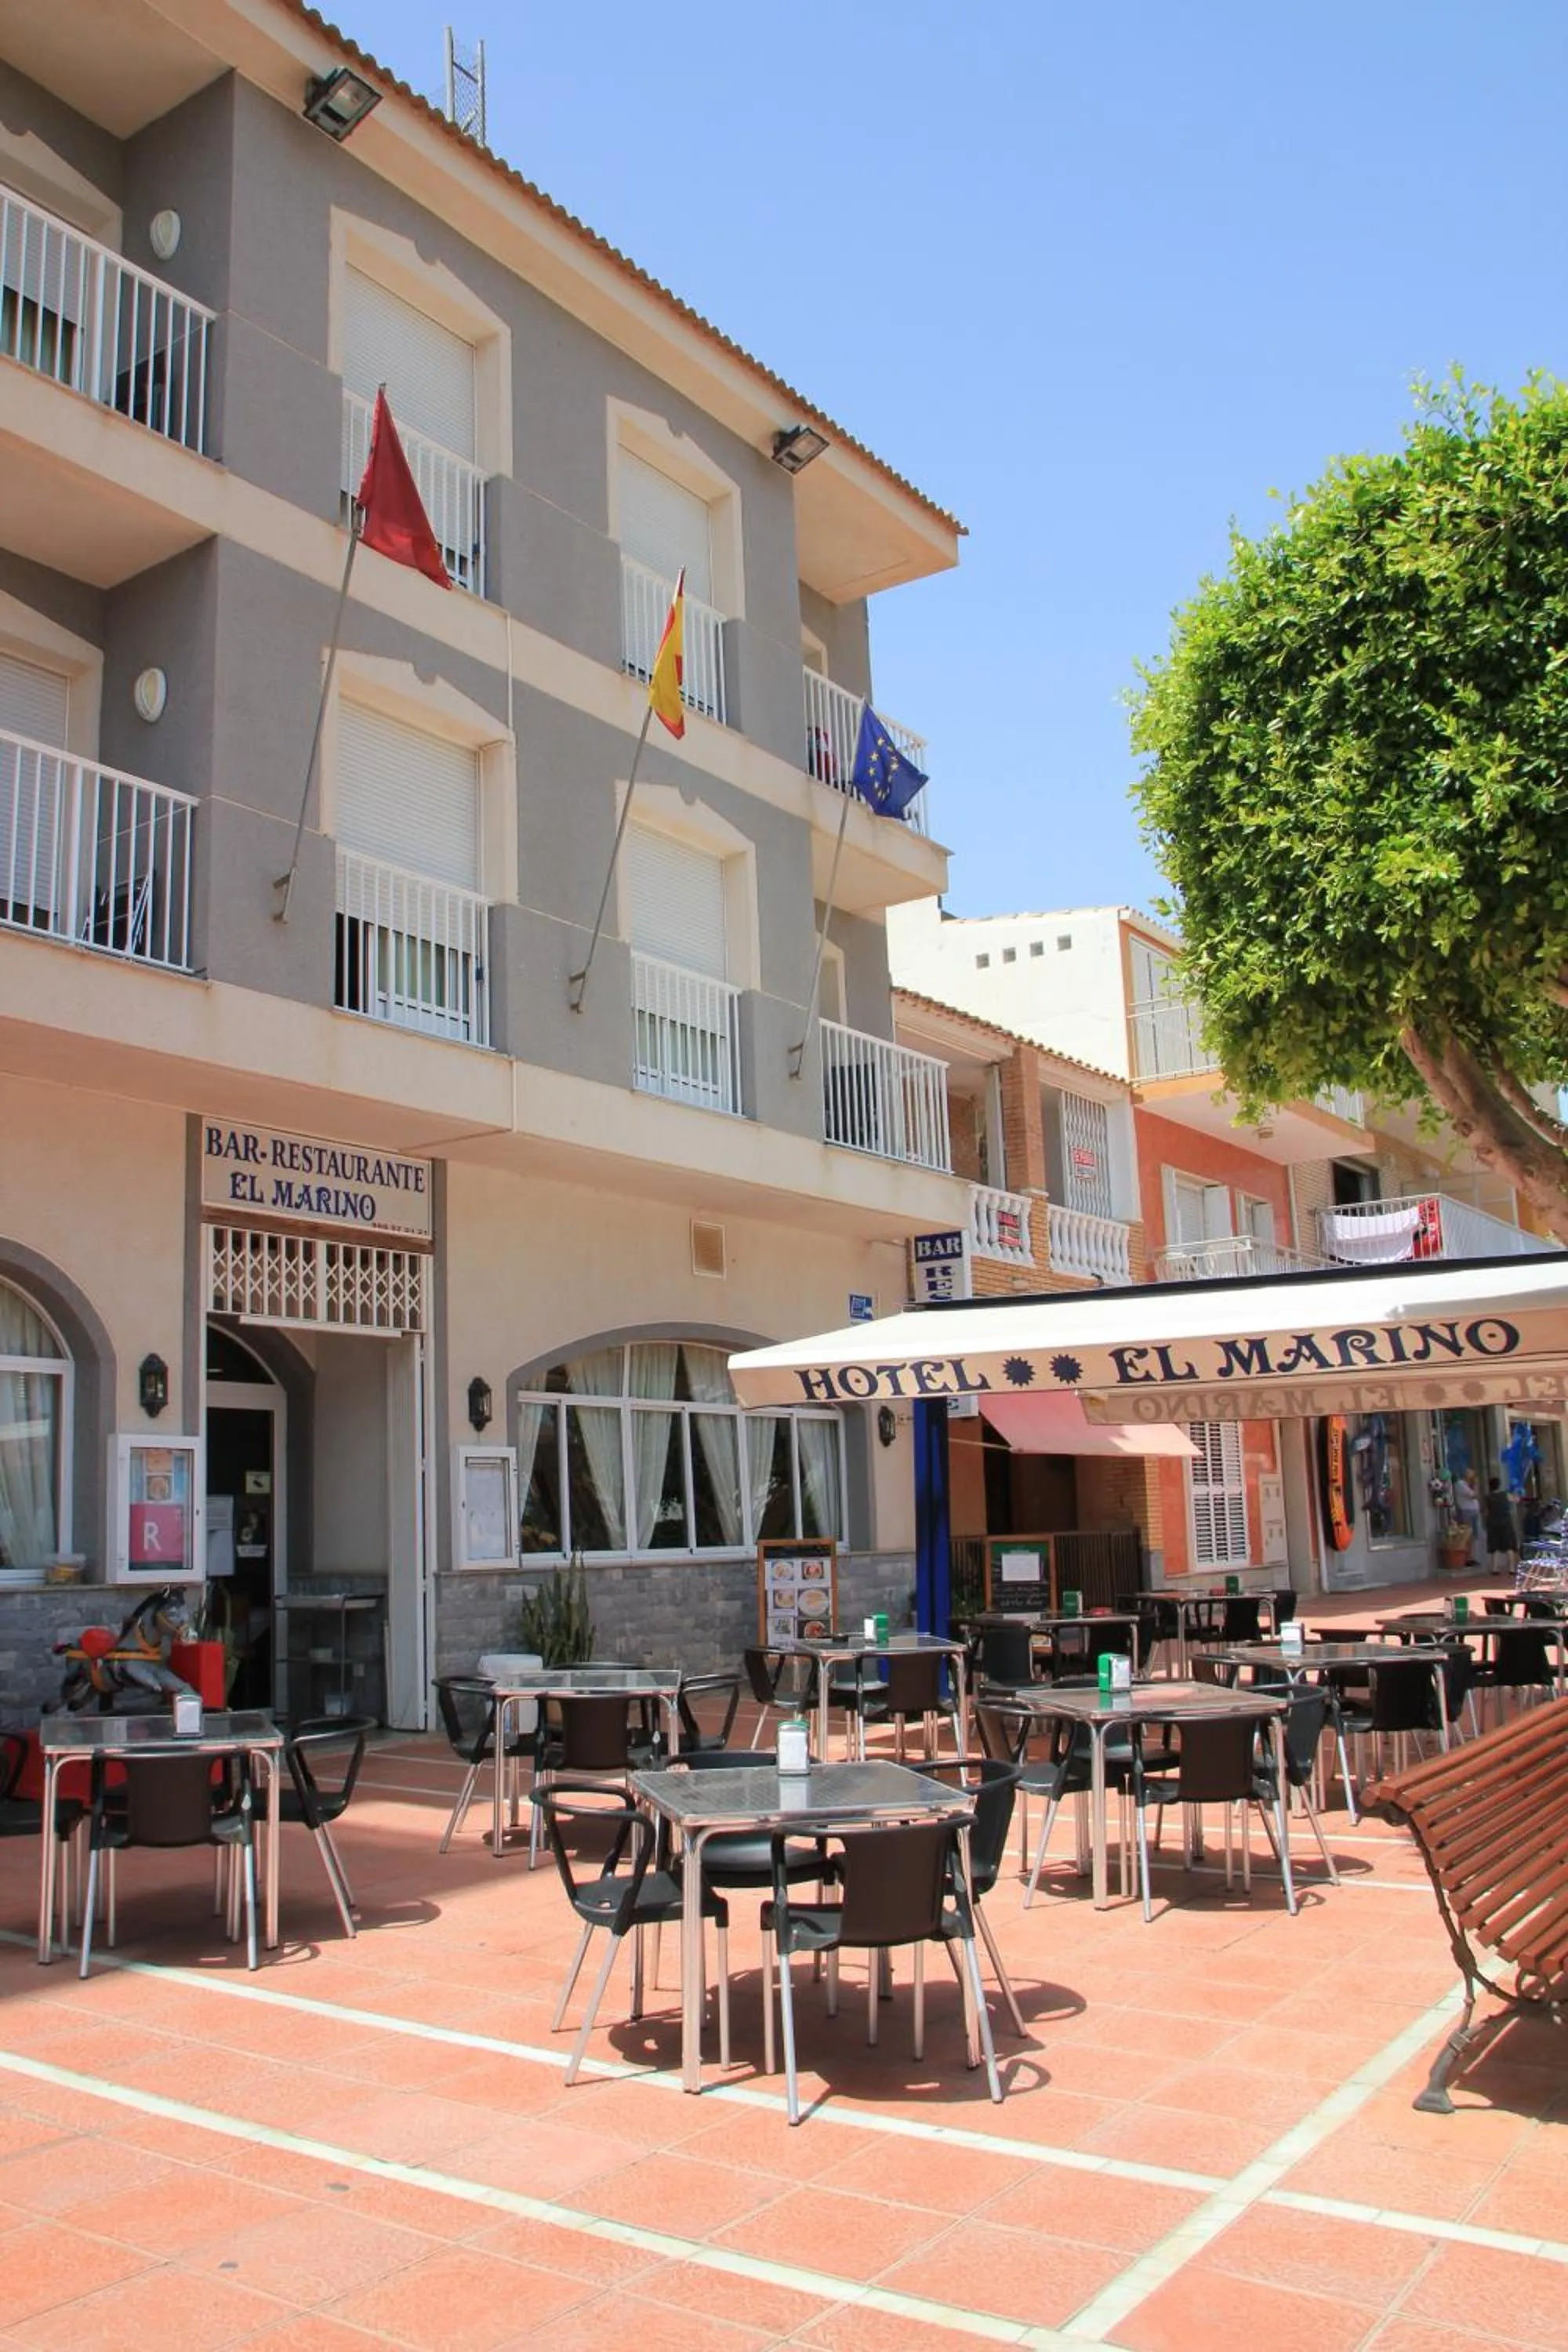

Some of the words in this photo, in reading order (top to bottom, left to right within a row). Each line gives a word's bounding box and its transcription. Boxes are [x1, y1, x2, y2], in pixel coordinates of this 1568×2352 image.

[270, 1139, 426, 1192] RESTAURANTE
[230, 1171, 265, 1203] EL
[272, 1178, 376, 1221] MARINO
[917, 1236, 962, 1257] BAR
[793, 1357, 991, 1401] HOTEL
[1108, 1345, 1200, 1384] EL
[1216, 1318, 1521, 1377] MARINO
